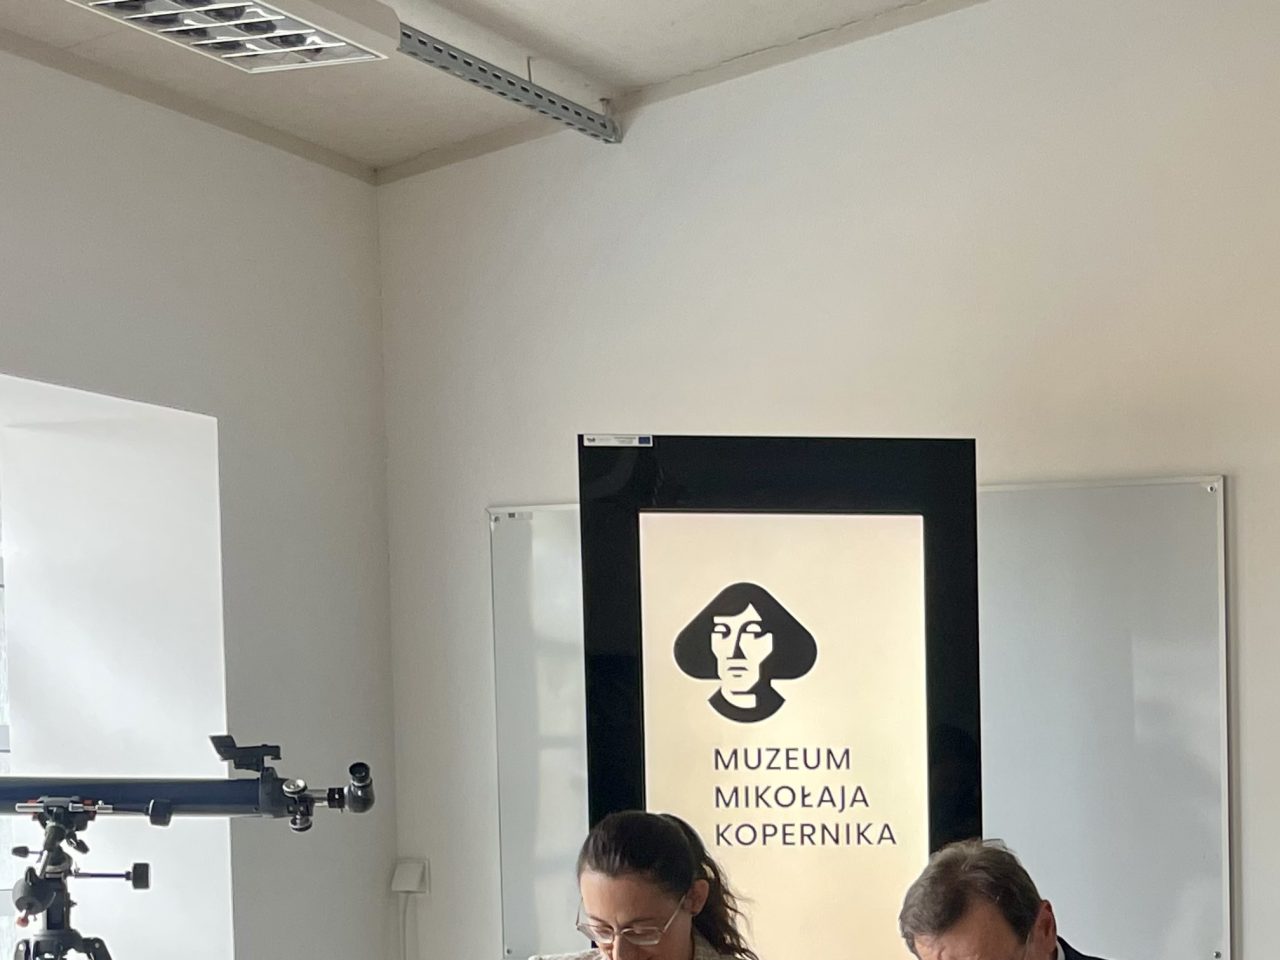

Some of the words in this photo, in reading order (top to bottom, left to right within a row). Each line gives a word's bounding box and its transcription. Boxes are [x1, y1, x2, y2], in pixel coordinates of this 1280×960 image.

[713, 747, 850, 771] MUZEUM
[714, 785, 870, 813] MIKOŁAJA
[715, 823, 897, 846] KOPERNIKA
